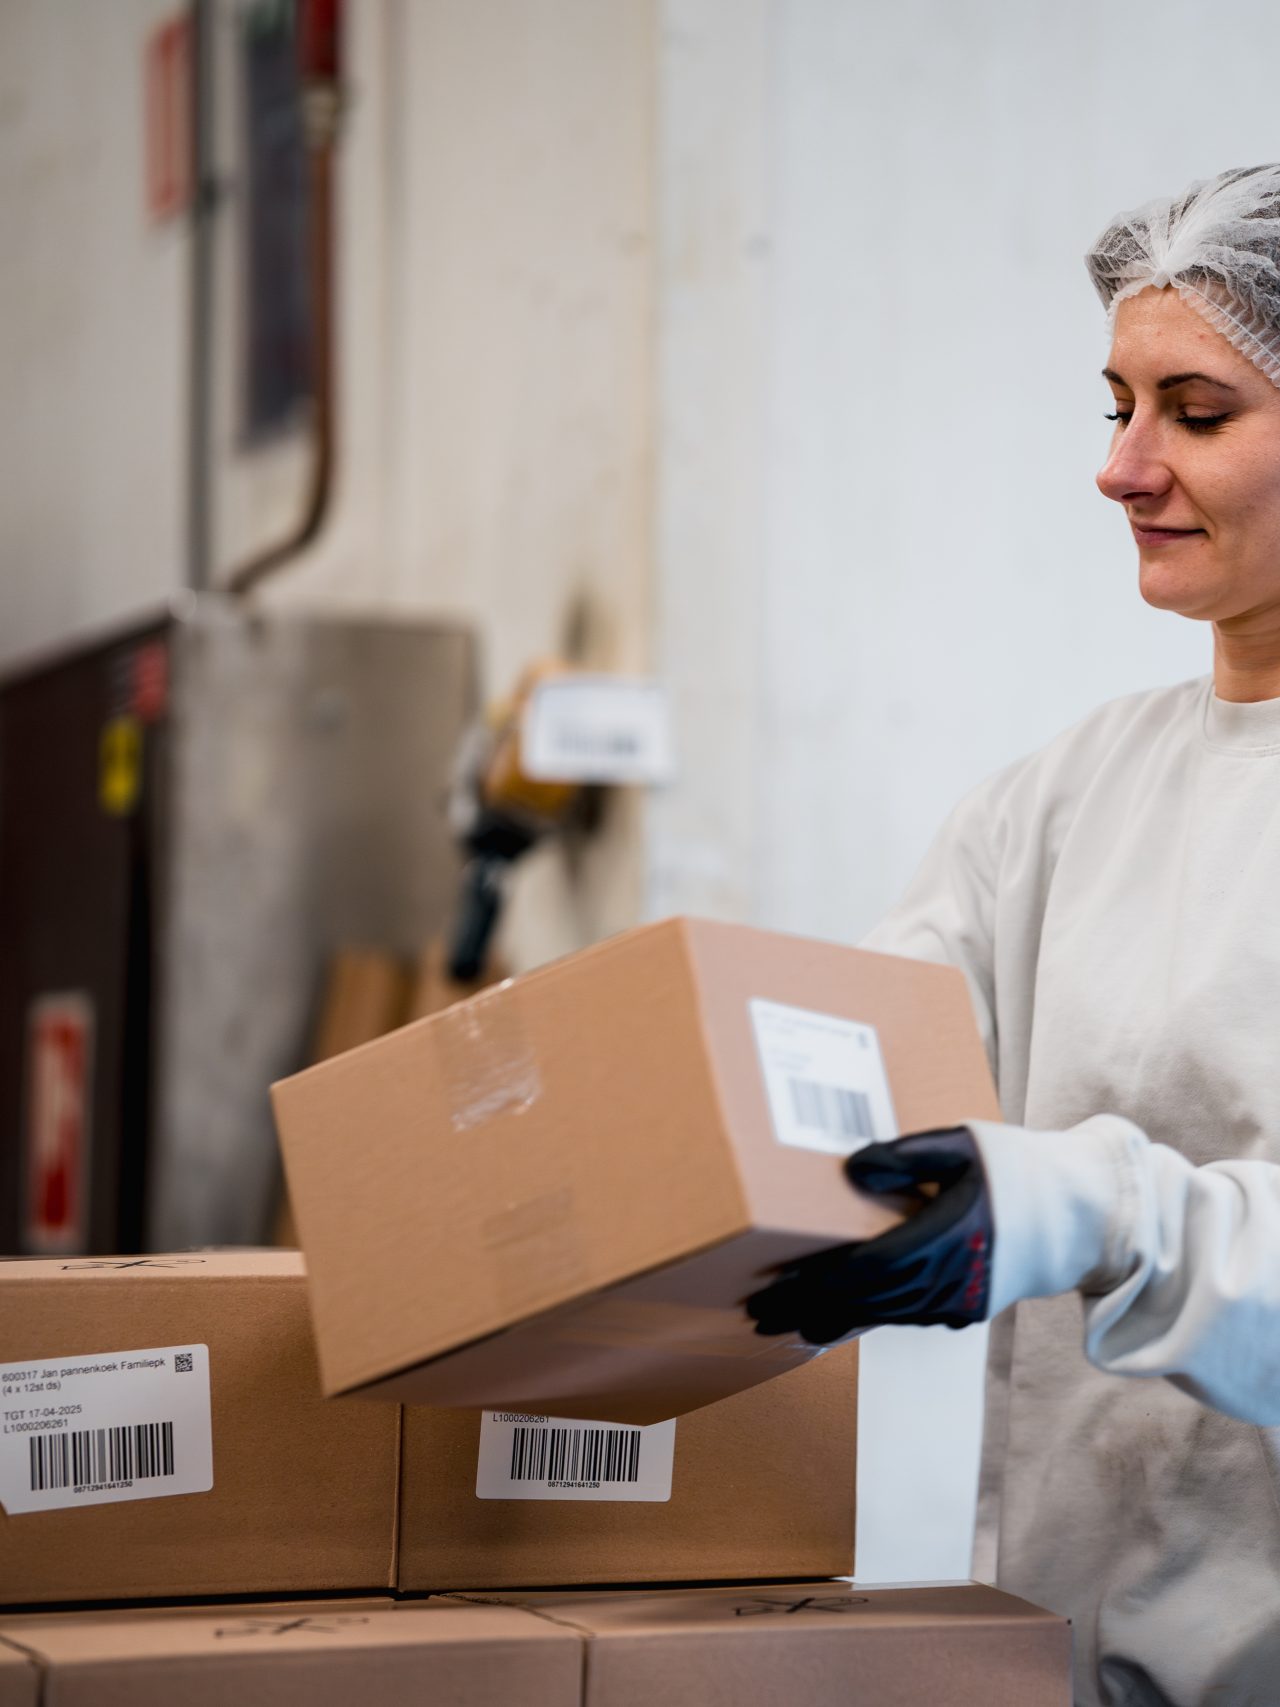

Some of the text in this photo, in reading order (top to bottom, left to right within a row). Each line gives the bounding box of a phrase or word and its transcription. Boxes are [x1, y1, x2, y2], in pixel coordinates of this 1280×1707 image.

[2, 1357, 166, 1382] 600317 Jan pannenkoek Familiepk
[2, 1385, 12, 1397] (4
[25, 1382, 44, 1392] 12st
[46, 1380, 61, 1391] ds)
[4, 1404, 82, 1421] TGT 17-04-2025
[492, 1412, 549, 1423] L1000206261
[3, 1418, 68, 1434] L1000206261
[547, 1481, 601, 1489] 08712941641250
